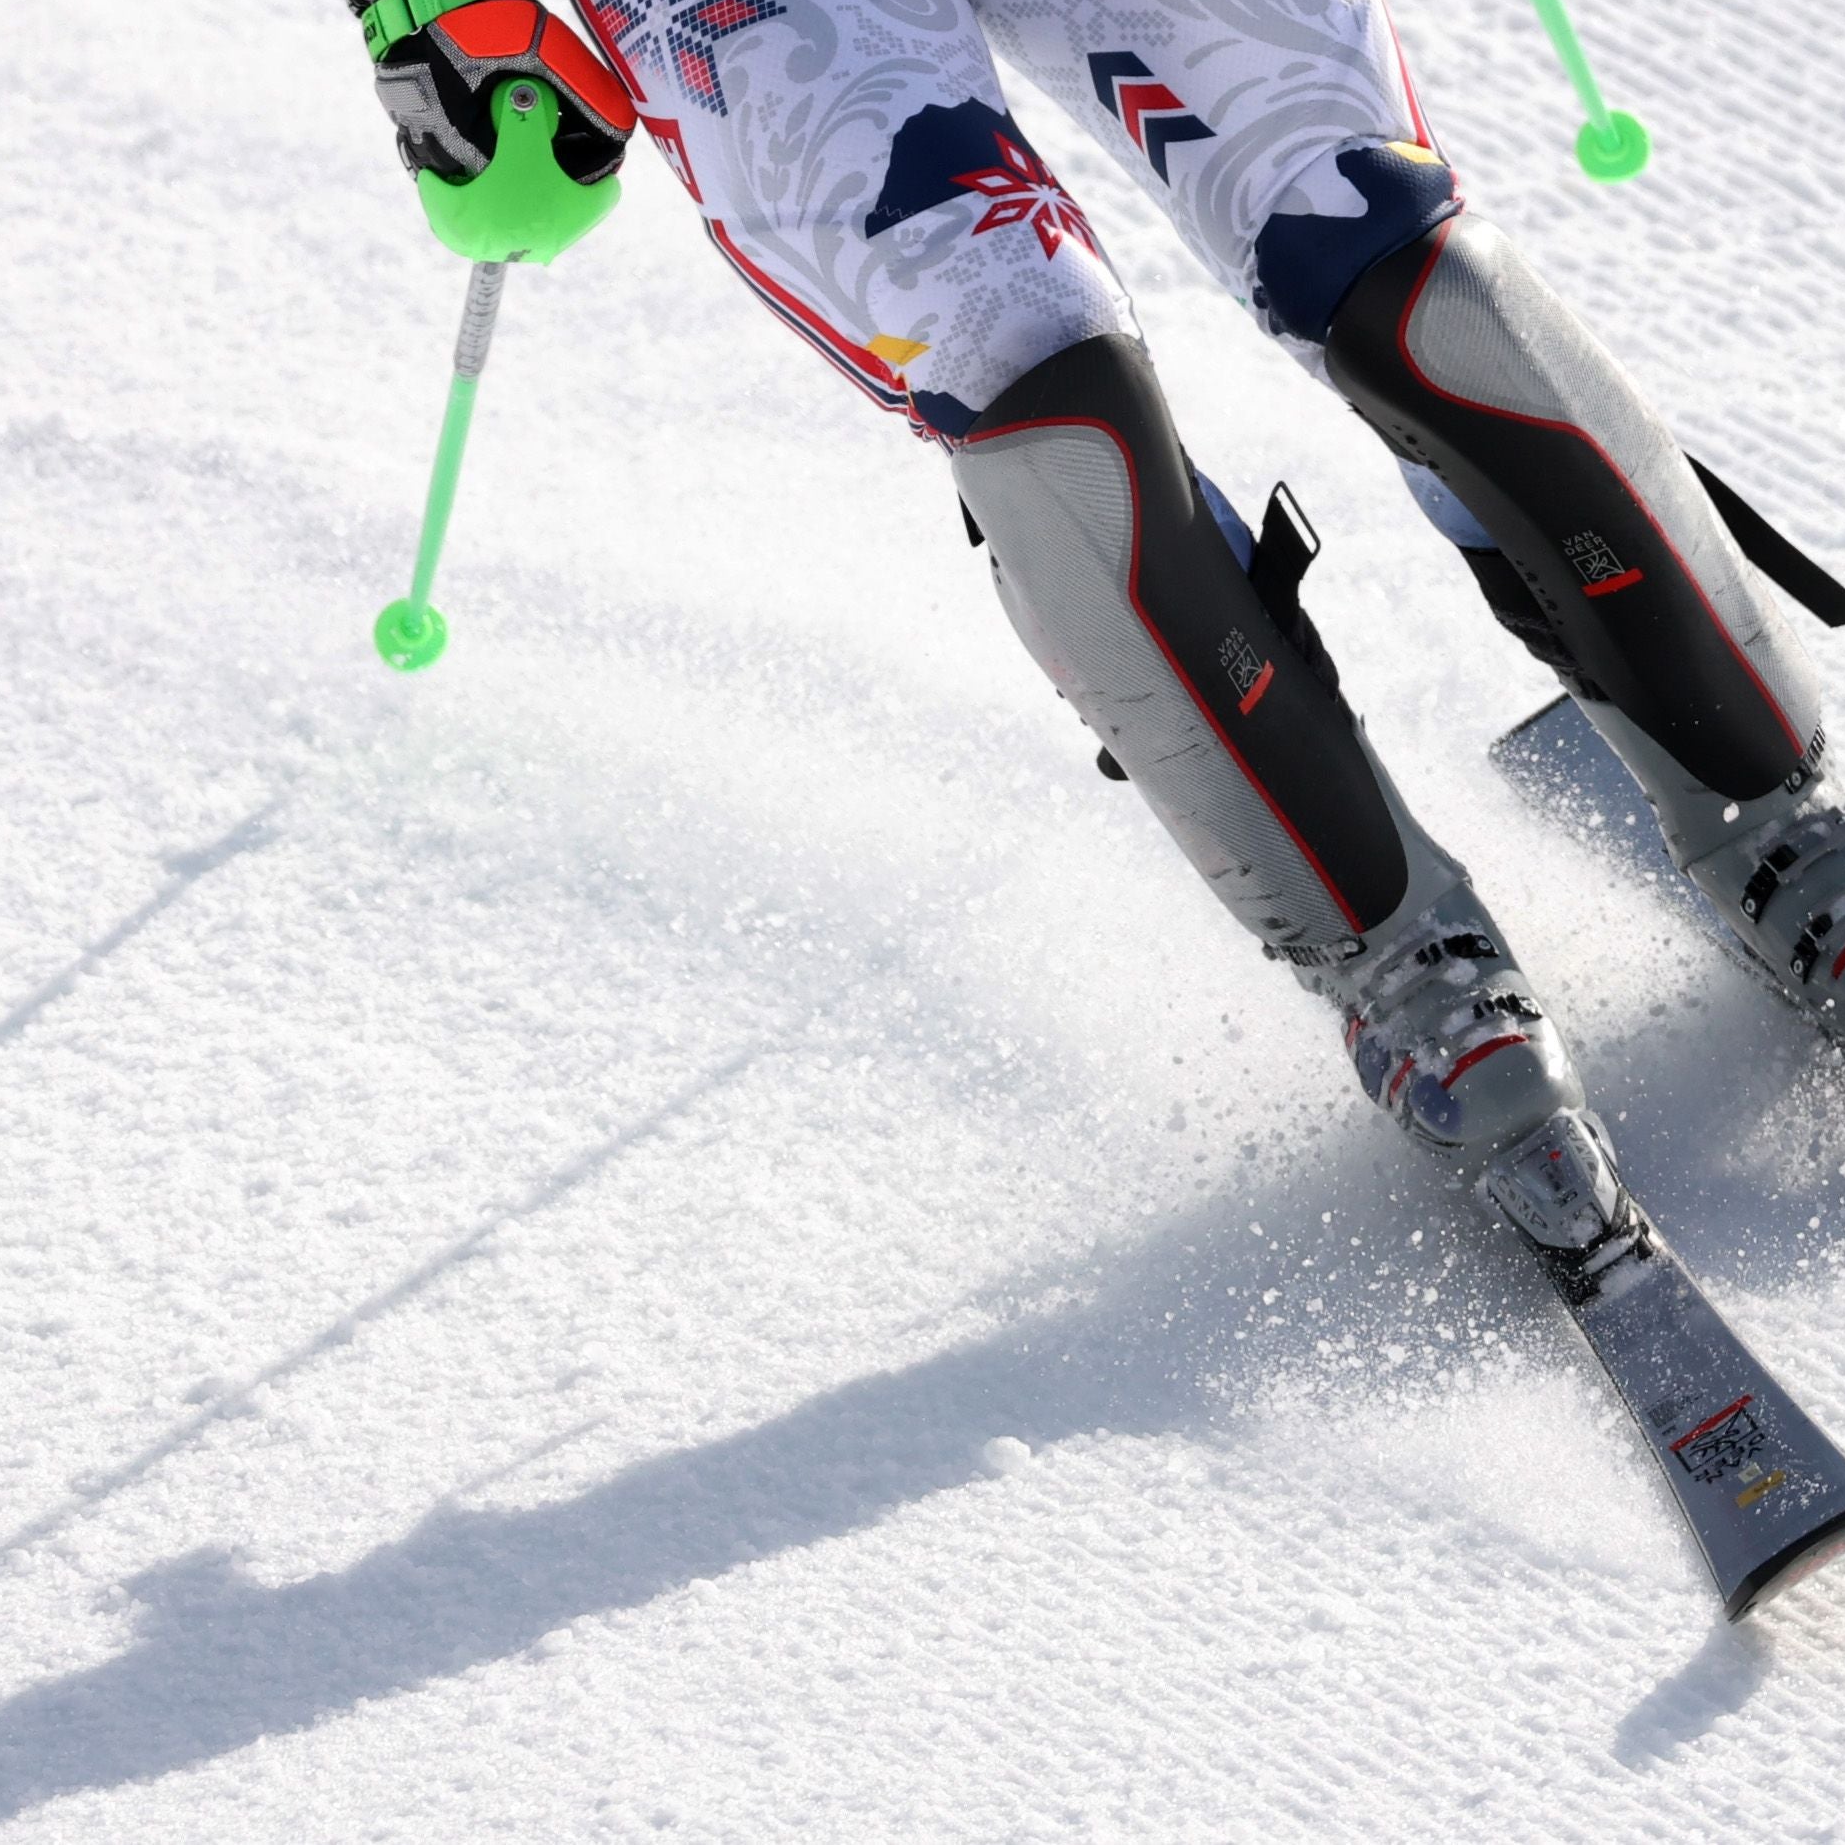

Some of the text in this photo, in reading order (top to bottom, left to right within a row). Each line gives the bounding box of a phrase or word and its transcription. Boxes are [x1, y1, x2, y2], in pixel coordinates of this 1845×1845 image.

[1562, 530, 1594, 547] VAN
[1564, 536, 1604, 556] DEER
[1217, 626, 1238, 654] VAN
[1220, 632, 1245, 666] DEER
[1694, 1432, 1766, 1482] DEER
[1707, 1446, 1763, 1484] VAN
